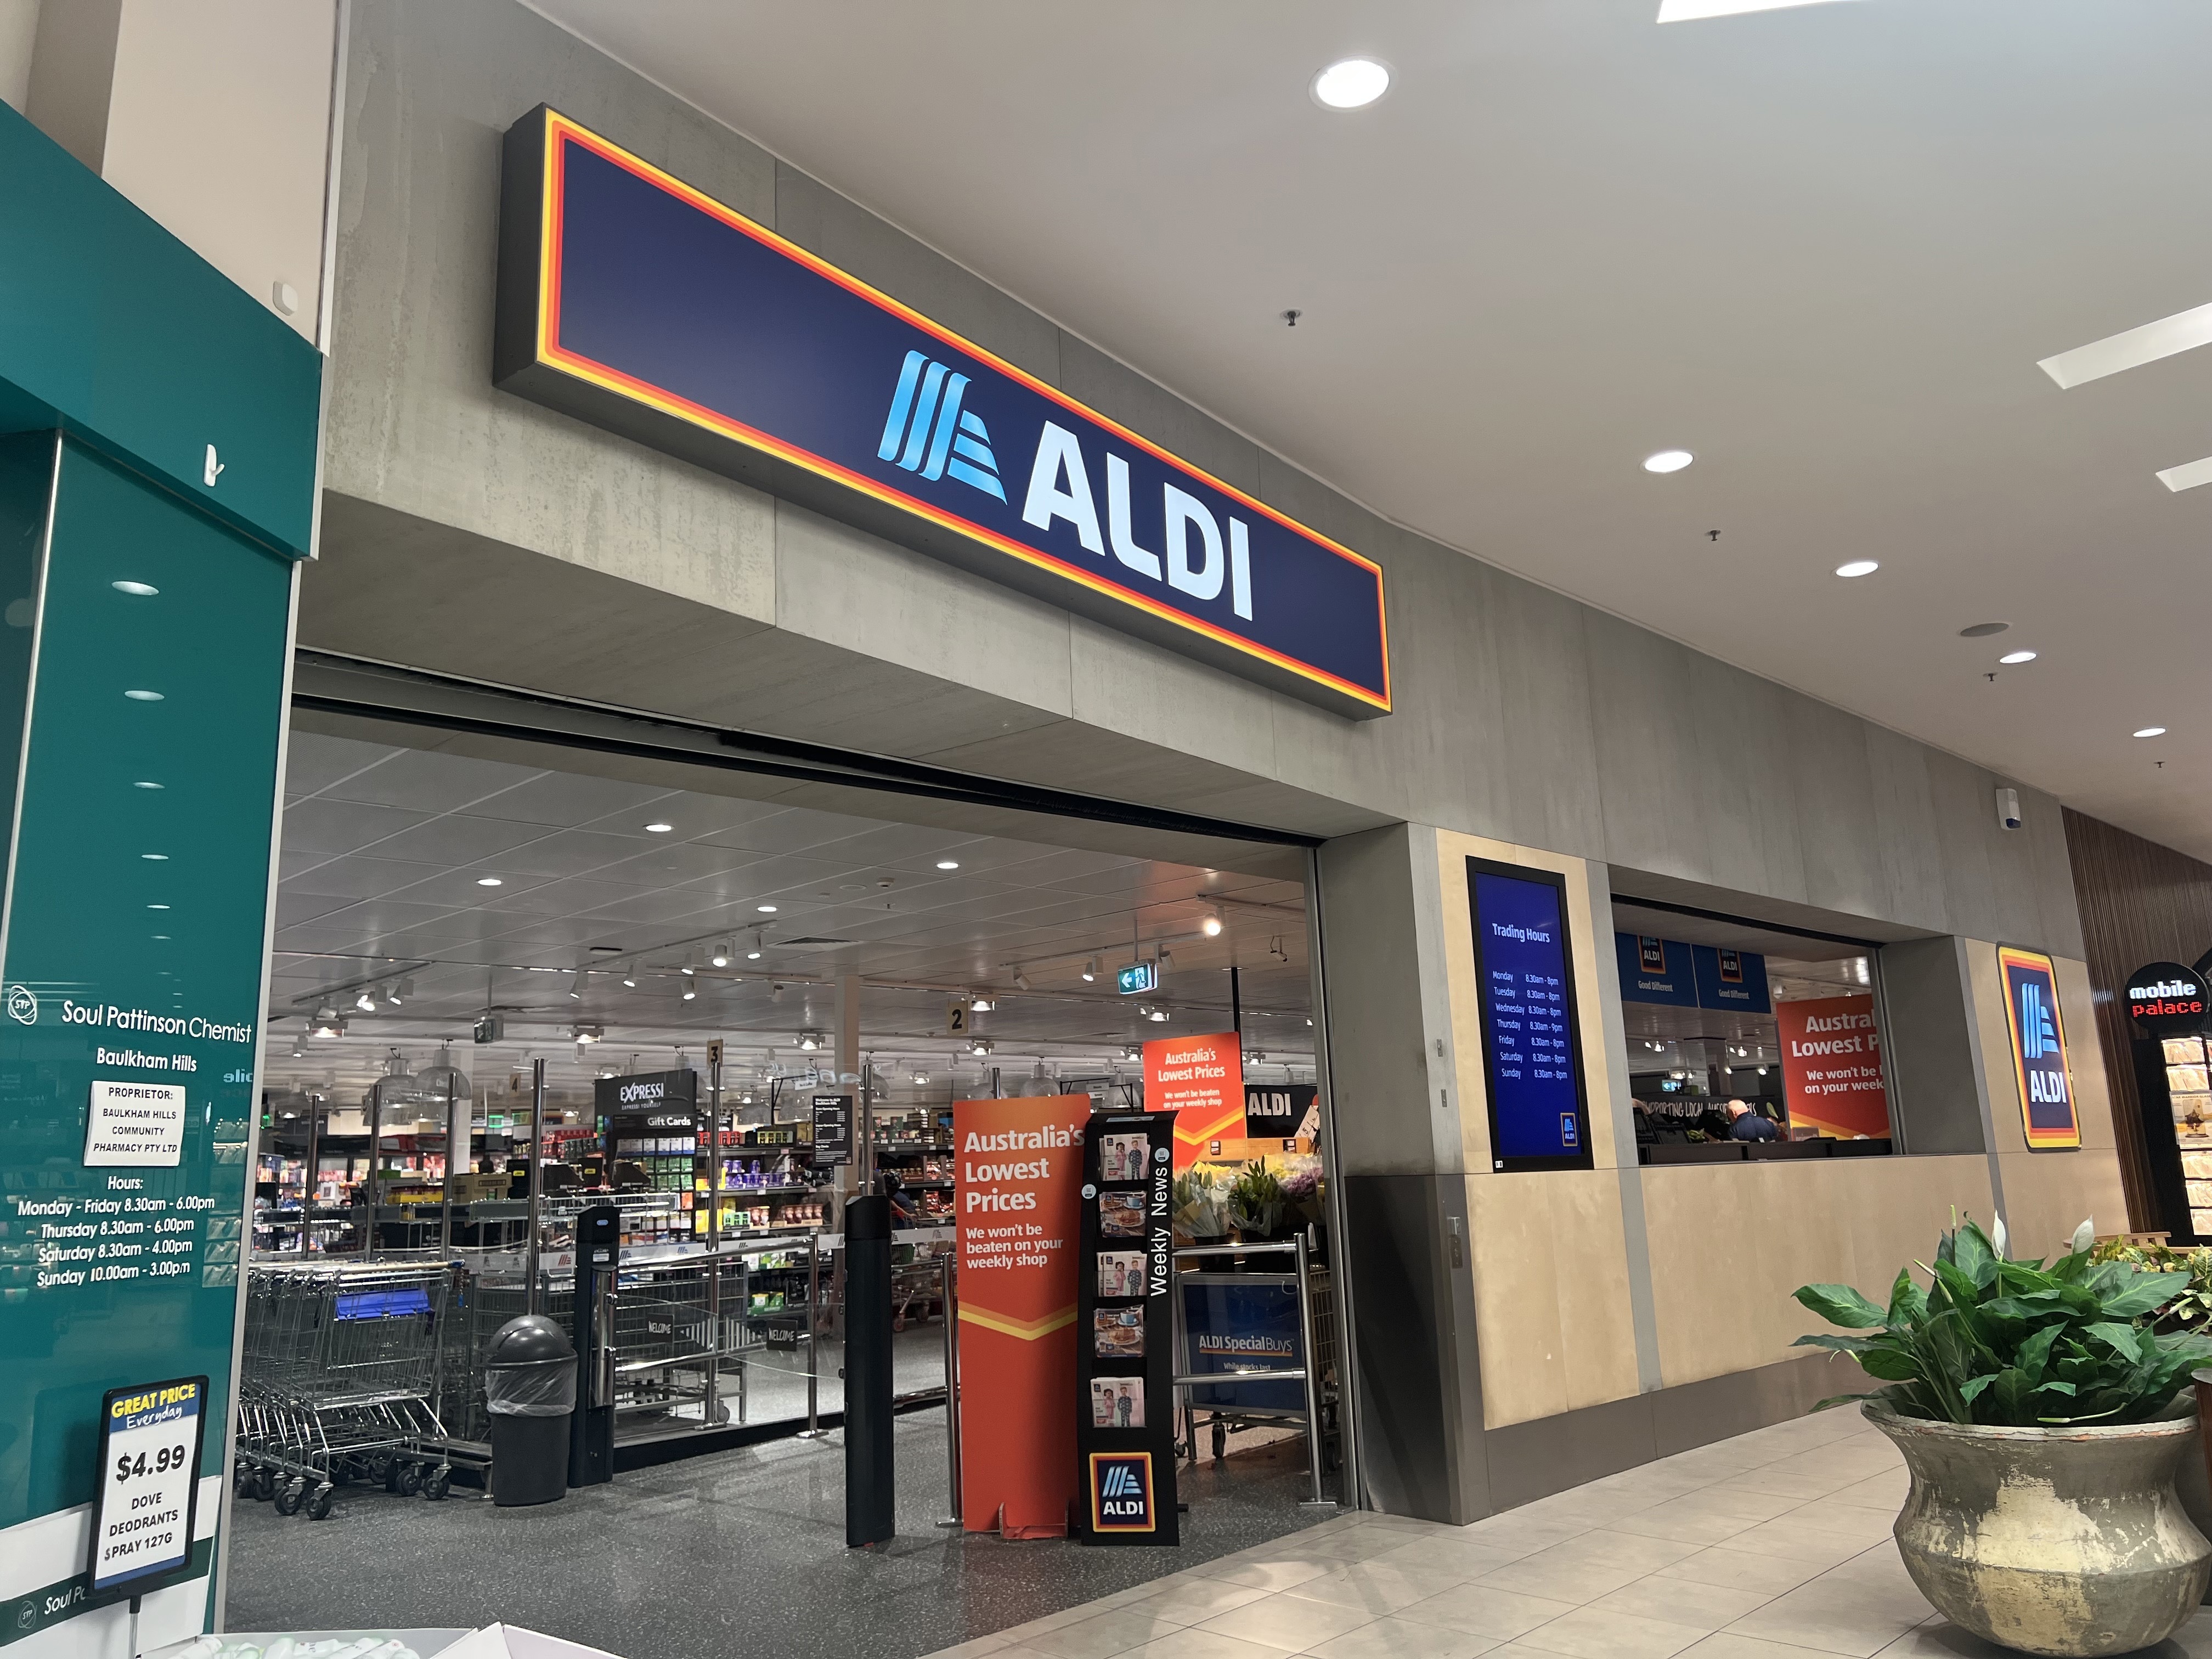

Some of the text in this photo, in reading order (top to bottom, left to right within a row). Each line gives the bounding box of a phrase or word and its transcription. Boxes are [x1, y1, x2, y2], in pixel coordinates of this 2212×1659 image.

[1022, 420, 1252, 622] ALDI
[1492, 922, 1550, 944] Trading Hours
[1644, 950, 1660, 961] ALDI
[1723, 960, 1738, 971] ALDI
[1493, 970, 1513, 983] Monday
[1494, 986, 1516, 998] Tuesday
[1638, 980, 1673, 992] Good Different
[1718, 989, 1750, 1000] Good Different
[2129, 979, 2197, 1000] mobile
[1496, 1002, 1525, 1015] Wednesday
[2132, 1000, 2203, 1018] palace
[15, 999, 252, 1043] STP Soul Pattinson Chemist
[951, 1009, 962, 1030] 2
[1497, 1019, 1521, 1031] Thursday
[1499, 1035, 1515, 1047] Friday
[1791, 1036, 1863, 1058] Lowest
[96, 1047, 198, 1073] Baulkham Hills
[710, 1046, 718, 1063] 3
[1165, 1047, 1216, 1065] Australia's
[1500, 1052, 1523, 1064] Saturday
[1158, 1064, 1225, 1082] Lowest Prices
[1502, 1068, 1521, 1079] Sunday
[1806, 1070, 1823, 1080] We
[1826, 1066, 1859, 1079] won't
[1861, 1066, 1876, 1077] be
[512, 1077, 518, 1092] 4
[620, 1082, 664, 1103] EXPRESSI
[1174, 1090, 1189, 1098] won't
[1199, 1088, 1220, 1097] beaten
[1804, 1085, 1820, 1094] on
[1822, 1083, 1848, 1096] your
[2030, 1070, 2067, 1104] ALDI
[109, 1087, 173, 1100] PROPRIETOR:
[1172, 1101, 1186, 1109] your
[1186, 1099, 1206, 1108] weekly
[1207, 1098, 1222, 1107] shop
[1248, 1092, 1292, 1116] ALDI
[1644, 1101, 1683, 1117] UPPORTING
[103, 1107, 177, 1120] BAULKHAM HILLS
[647, 1116, 691, 1126] Gift Cards
[112, 1126, 165, 1136] COMMUNITY
[963, 1124, 1085, 1153] Australia's
[93, 1143, 178, 1153] PHARMACY PTY LTD
[964, 1156, 1049, 1183] Lowest
[108, 1176, 143, 1191] Hours:
[18, 1200, 73, 1218] Monday
[84, 1198, 123, 1217] Friday
[124, 1198, 166, 1212] 8.30am
[176, 1196, 216, 1211] 6.00pm
[966, 1188, 1036, 1214] Prices
[41, 1222, 98, 1240] Thursday
[100, 1221, 143, 1235] 8.30am
[154, 1218, 195, 1234] 6.00pm
[966, 1223, 1042, 1240] We won't be
[1150, 1167, 1171, 1297] Weekly News
[38, 1245, 95, 1265] Saturday
[98, 1243, 142, 1259] 8.30am
[152, 1239, 193, 1255] 4.00pm
[966, 1239, 1063, 1255] beaten on your
[967, 1252, 1048, 1270] weekly shop
[37, 1268, 86, 1288] Sunday
[90, 1265, 139, 1283] 10.00am
[149, 1261, 190, 1277] 3.00pm
[648, 1321, 672, 1335] WELCOME
[768, 1327, 794, 1342] WELCOME
[1199, 1335, 1223, 1349] ALDI
[1223, 1362, 1239, 1370] While
[111, 1383, 196, 1419] GREAT PRICE
[126, 1404, 183, 1429] Everyday
[116, 1444, 185, 1485] $4.99
[131, 1492, 162, 1510] DOVE
[1103, 1500, 1144, 1515] ALDI
[109, 1509, 178, 1537] DEODRANTS
[104, 1532, 173, 1561] SPRAY 127G
[22, 1609, 33, 1620] STP
[44, 1589, 72, 1615] Soul
